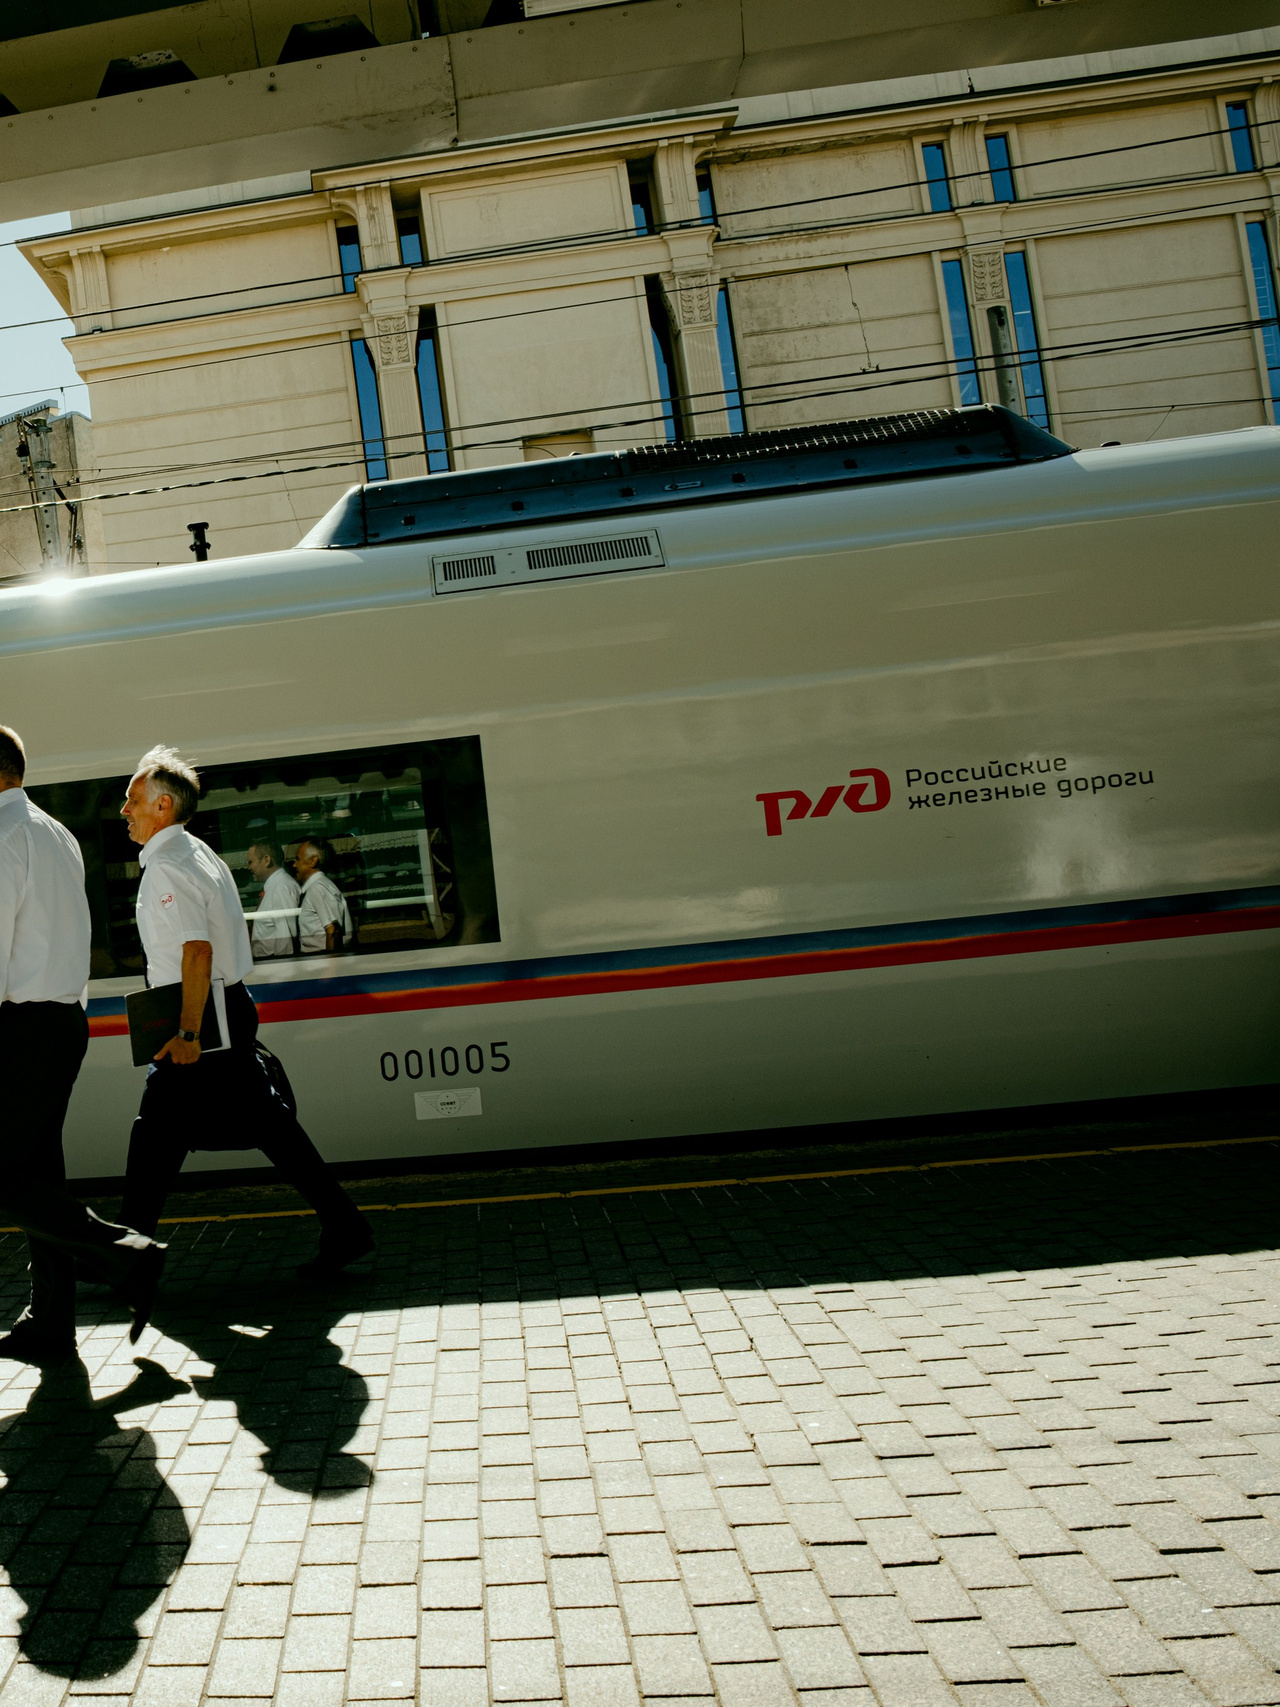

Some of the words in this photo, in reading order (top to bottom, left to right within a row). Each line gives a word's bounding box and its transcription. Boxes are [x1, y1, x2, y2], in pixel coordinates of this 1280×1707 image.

[906, 758, 1067, 788] Российские
[908, 782, 1046, 810] железные
[1057, 770, 1155, 799] дороги
[380, 1041, 511, 1082] 001005
